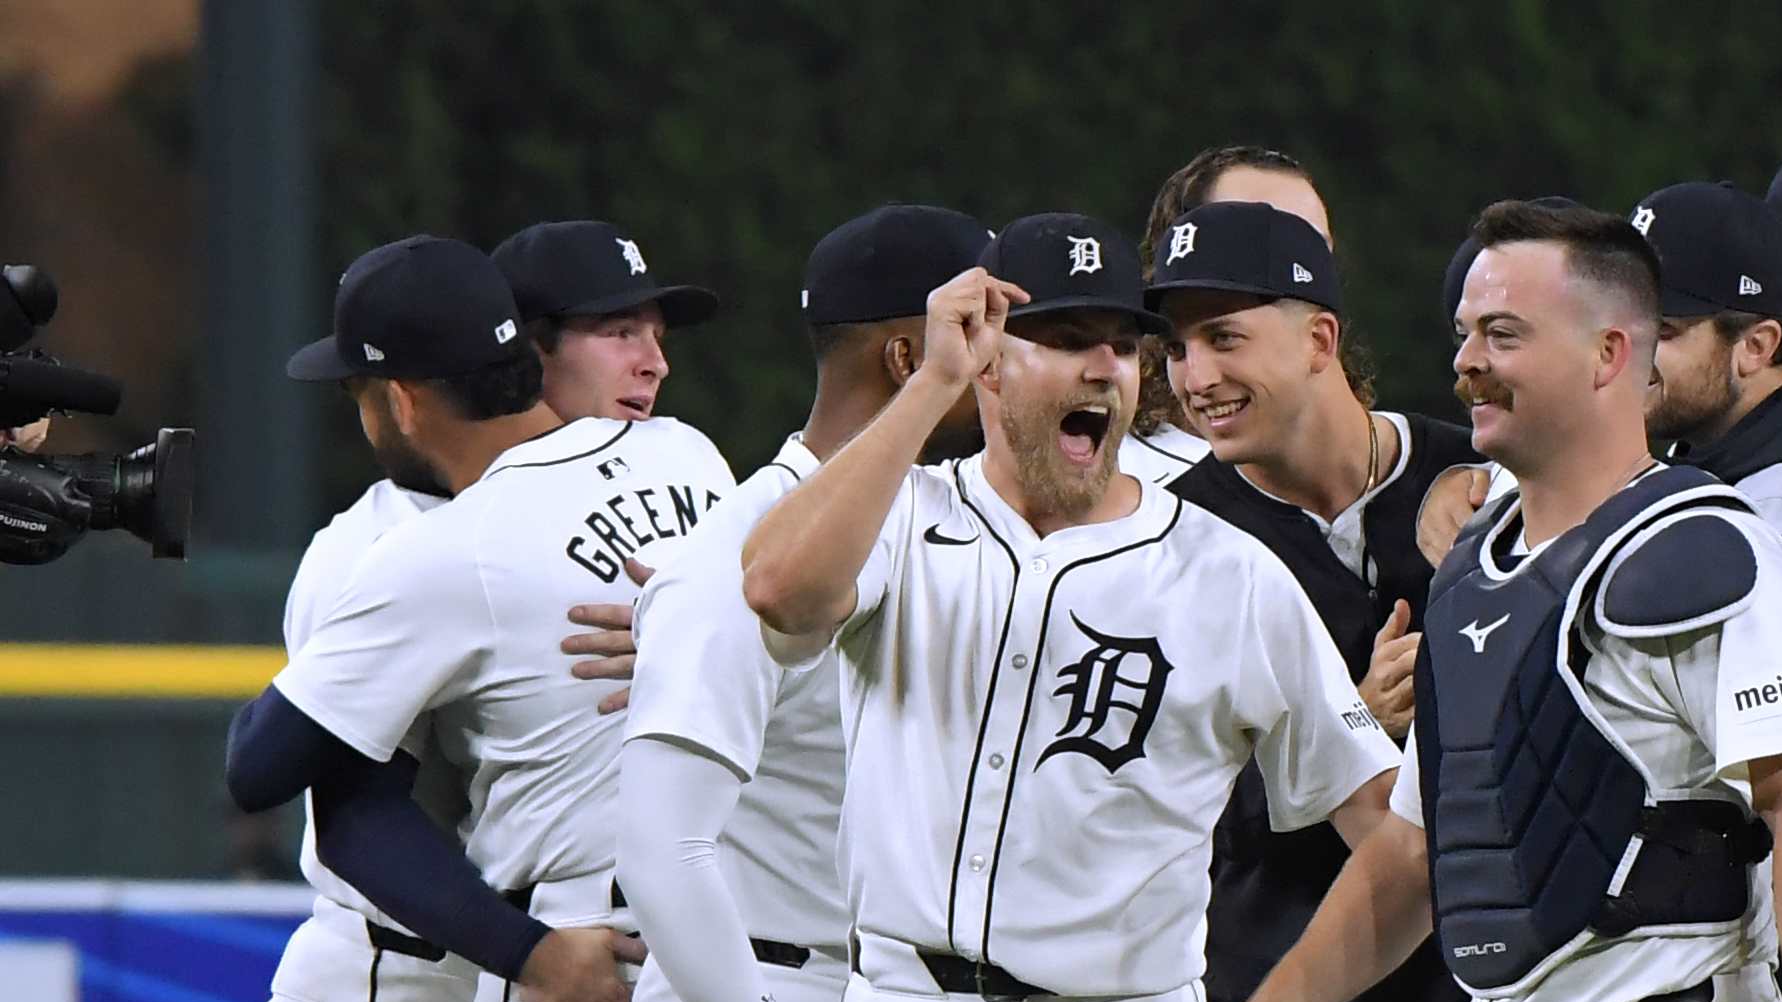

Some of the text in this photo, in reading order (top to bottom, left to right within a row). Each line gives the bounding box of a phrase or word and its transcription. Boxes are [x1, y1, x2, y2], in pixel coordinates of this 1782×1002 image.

[615, 237, 647, 276] D
[1067, 235, 1102, 276] D
[1166, 222, 1198, 266] D
[566, 485, 722, 583] GREEN
[1033, 609, 1175, 775] D
